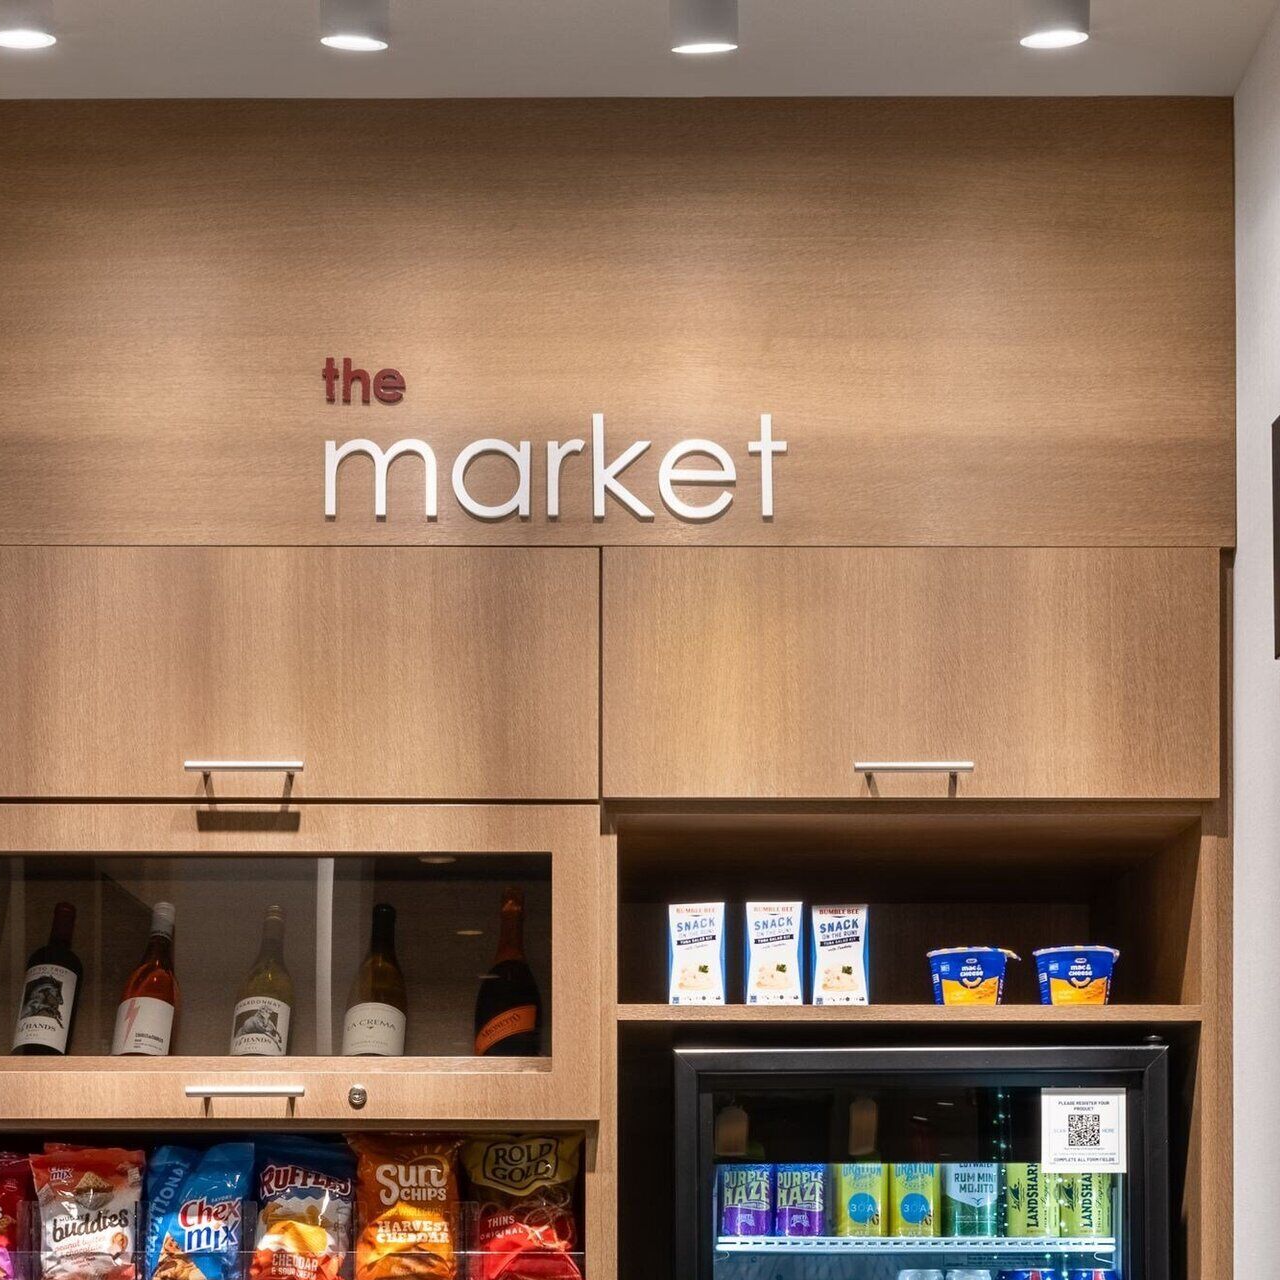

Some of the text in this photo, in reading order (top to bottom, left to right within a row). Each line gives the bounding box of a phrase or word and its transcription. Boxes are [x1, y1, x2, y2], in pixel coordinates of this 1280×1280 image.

[322, 357, 406, 405] the
[324, 413, 788, 519] market
[676, 917, 716, 933] SNACK
[754, 917, 793, 931] SNACK
[820, 919, 859, 934] SNACK
[494, 1142, 553, 1165] ROLD
[260, 1165, 352, 1200] RUFFLES
[491, 1163, 551, 1183] GOLD
[400, 1188, 447, 1201] CHIPS
[725, 1184, 771, 1204] HAZE
[777, 1184, 824, 1204] HAZE
[959, 1184, 994, 1194] MOJITO
[178, 1200, 242, 1228] Chex
[487, 1215, 515, 1228] THINS
[52, 1211, 129, 1242] buddies
[376, 1220, 449, 1233] HARVEST
[184, 1224, 239, 1253] mix
[272, 1253, 318, 1270] CHEDDAR
